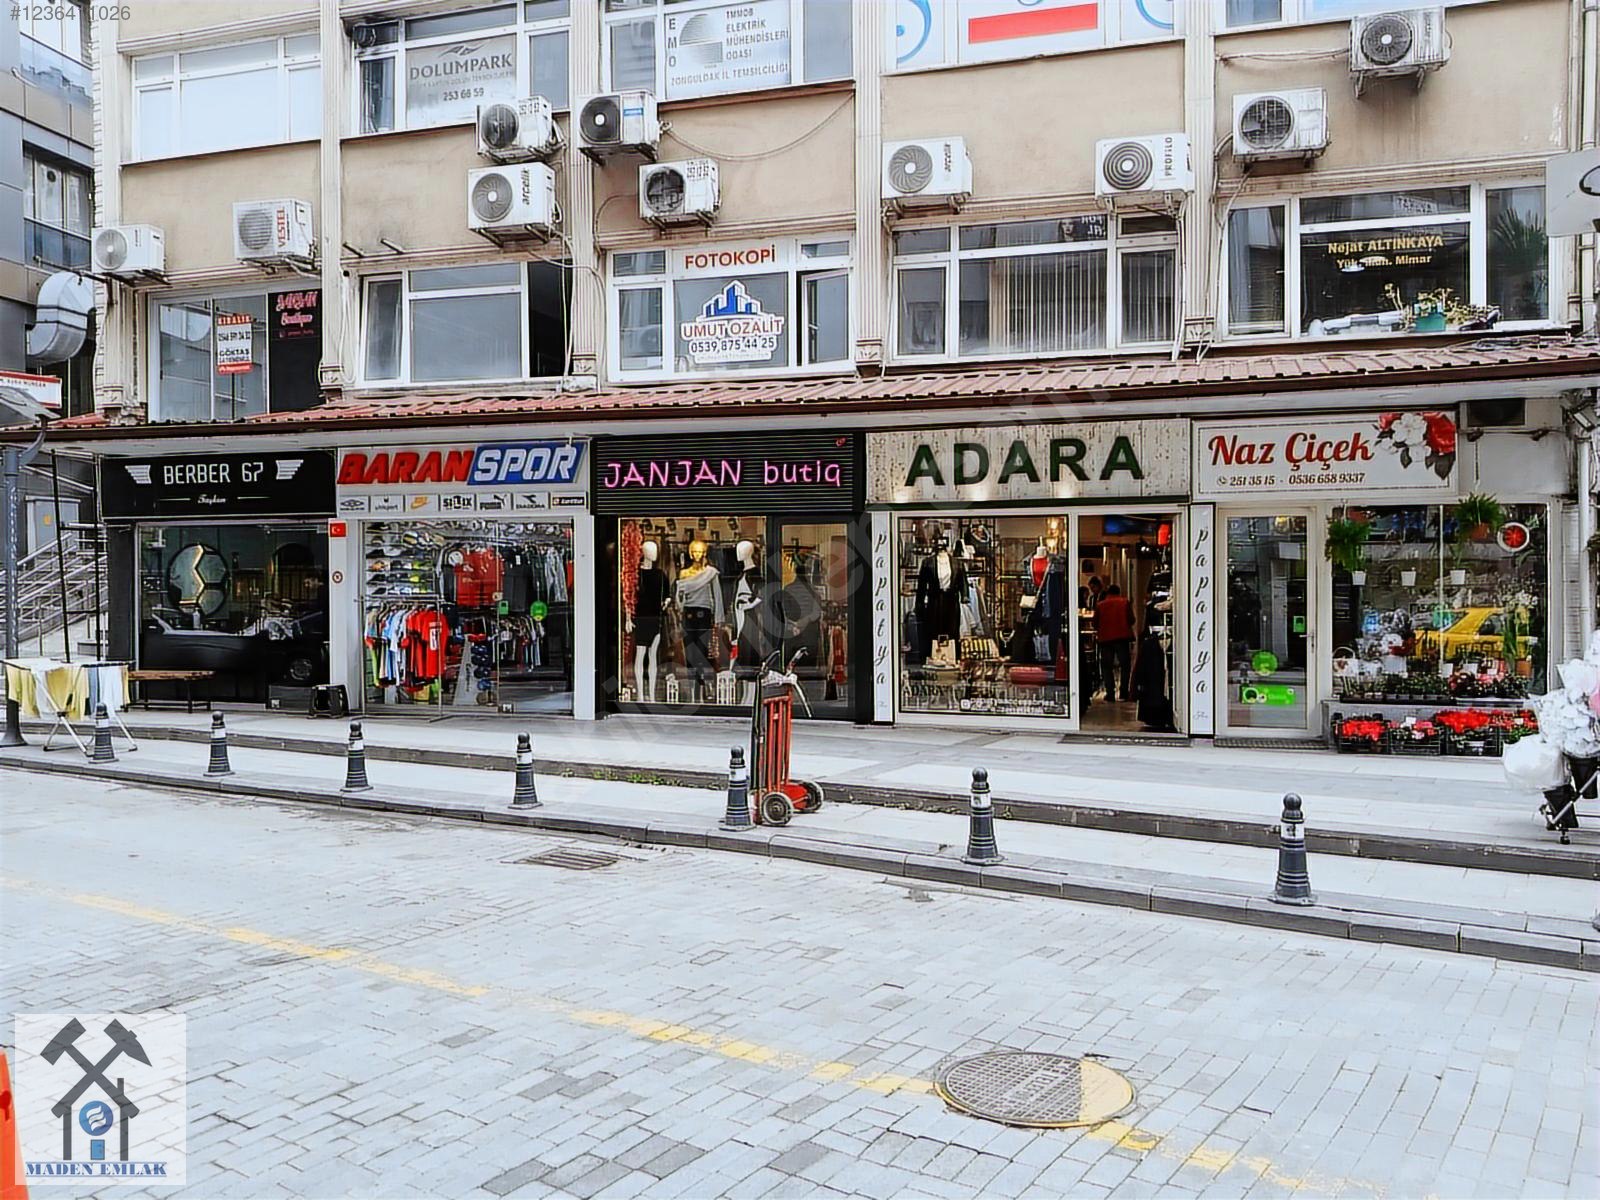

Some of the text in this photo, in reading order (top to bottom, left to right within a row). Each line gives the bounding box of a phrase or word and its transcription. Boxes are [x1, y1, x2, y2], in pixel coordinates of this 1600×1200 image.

[410, 53, 512, 80] DOLUMPARK
[685, 244, 775, 269] FOTOKOPİ
[1368, 235, 1444, 252] ALTINKAYA
[683, 323, 726, 338] UMUT
[691, 341, 717, 353] 0539
[721, 339, 741, 351] 875
[762, 337, 774, 348] 25
[904, 436, 1145, 486] ADARA
[1208, 432, 1375, 471] Naz Çiçek
[164, 462, 264, 485] BERBER 67
[337, 447, 577, 484] BARAN SPOR
[604, 460, 841, 487] JANJAN butiq
[1230, 476, 1246, 486] 251
[1249, 475, 1263, 485] 35
[1289, 474, 1315, 485] 0536
[1317, 473, 1337, 484] 658
[1339, 472, 1366, 483] 9337
[874, 531, 887, 685] papatya
[1193, 527, 1210, 693] papatya
